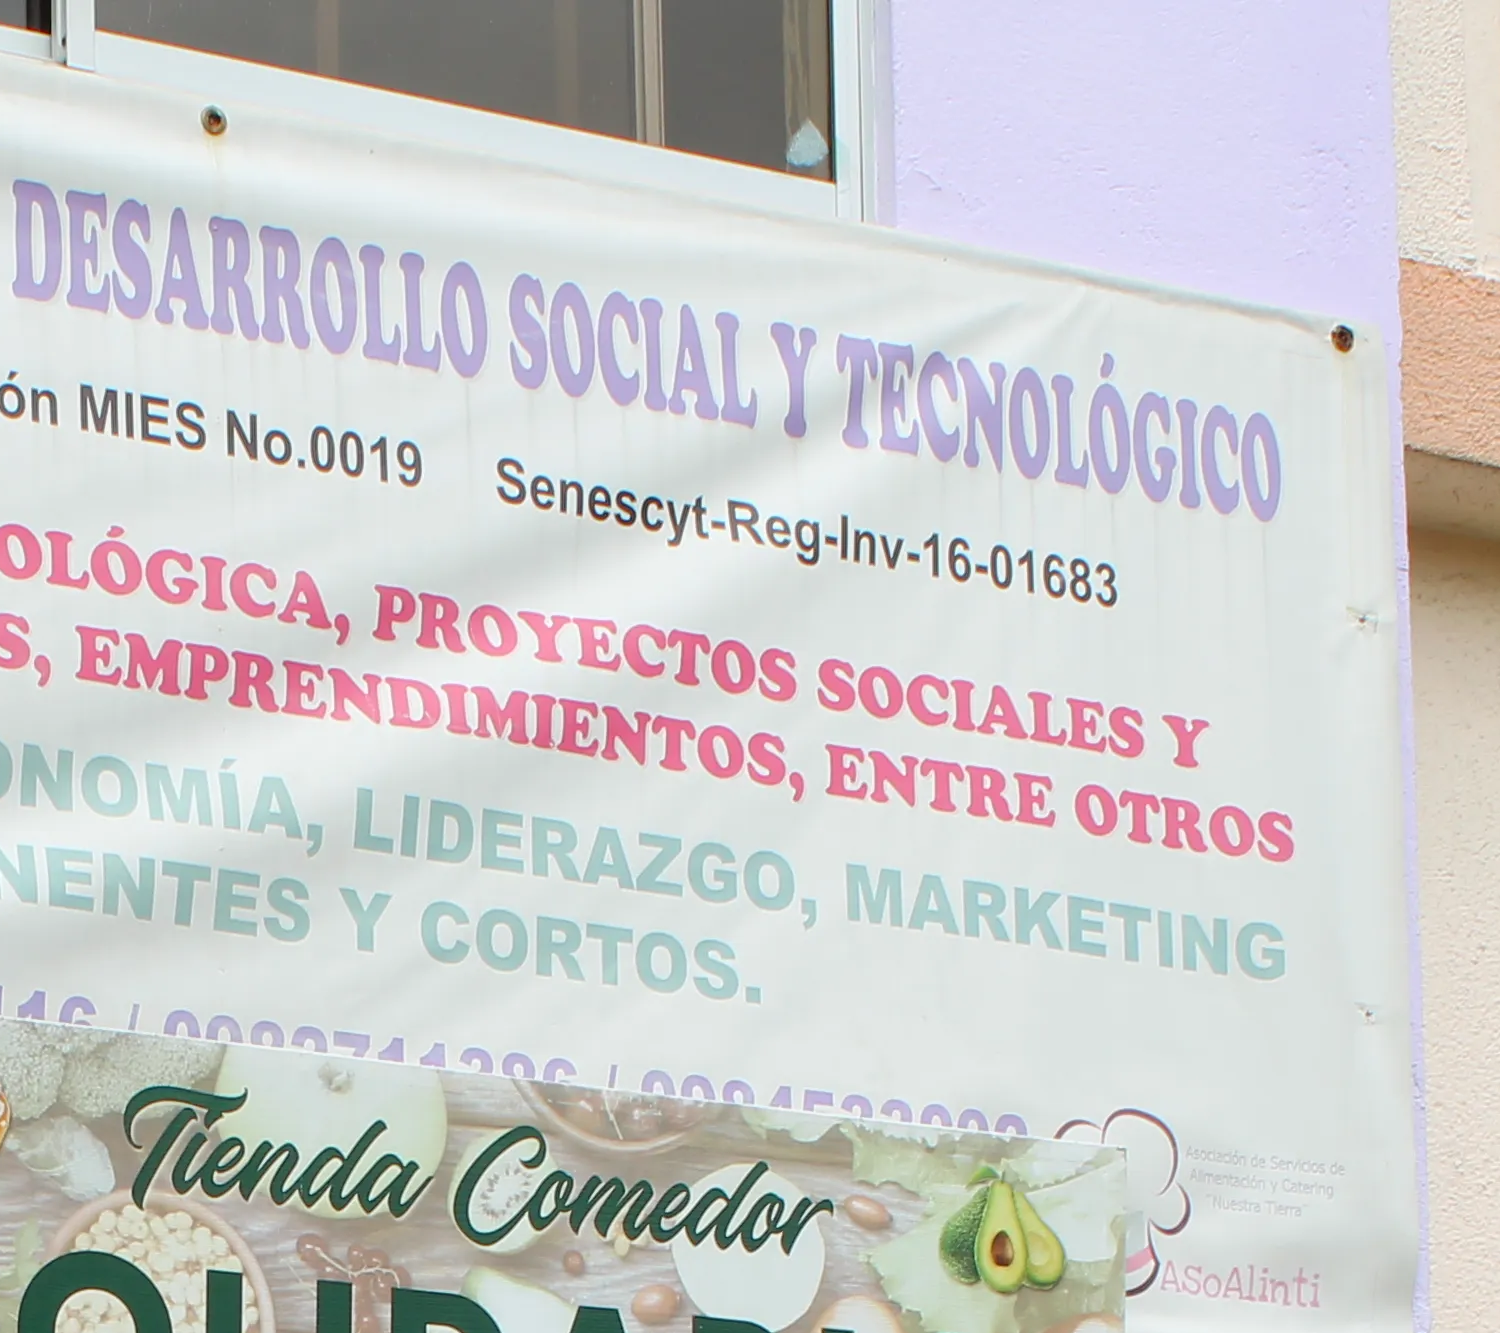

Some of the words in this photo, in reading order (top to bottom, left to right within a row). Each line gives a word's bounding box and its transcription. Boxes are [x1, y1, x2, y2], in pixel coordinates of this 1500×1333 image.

[11, 179, 488, 380] DESARROLLO
[508, 271, 759, 430] SOCIAL
[770, 320, 817, 439] Y
[836, 333, 1281, 524] TECNOLÓGICO
[78, 384, 207, 450] MIES
[226, 412, 424, 488] No.0019
[495, 456, 1117, 607] Senescyt-Reg-Inv-16-01683
[75, 626, 805, 802] EMPRENDIMIENTOS,
[824, 745, 1056, 828] ENTRE
[1073, 784, 1295, 863] OTROS
[372, 583, 797, 703] PROYECTOS
[816, 658, 1144, 761] SOCIALES
[1162, 714, 1209, 769] Y
[338, 886, 392, 953] Y
[420, 899, 763, 1003] CORTOS.
[352, 787, 819, 931] LIDERAZGO,
[845, 864, 1288, 981] MARKETING
[123, 1083, 436, 1218] Tienda
[451, 1125, 834, 1255] Comedor
[1250, 1152, 1266, 1168] de
[1270, 1155, 1326, 1174] Servicios
[1330, 1162, 1346, 1176] de
[1270, 1181, 1279, 1194] y
[1281, 1179, 1334, 1199] Catering
